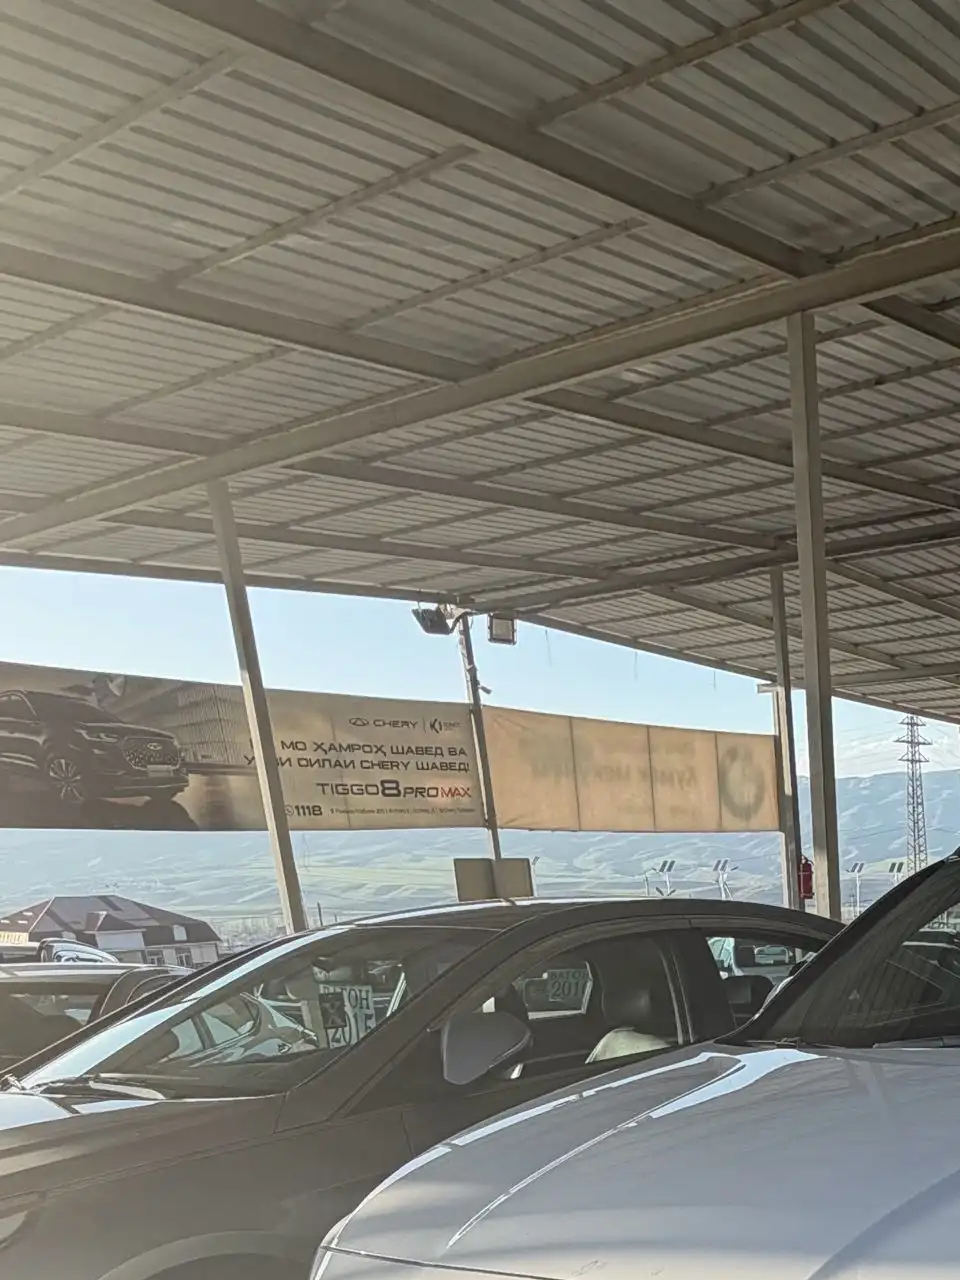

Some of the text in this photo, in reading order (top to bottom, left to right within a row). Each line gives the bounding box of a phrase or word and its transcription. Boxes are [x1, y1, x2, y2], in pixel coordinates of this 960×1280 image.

[373, 719, 418, 729] CHERY
[281, 740, 307, 751] МО
[390, 745, 444, 757] ШАВЕД
[448, 746, 467, 756] ВА
[360, 760, 410, 770] CHERY
[294, 804, 323, 816] 1118
